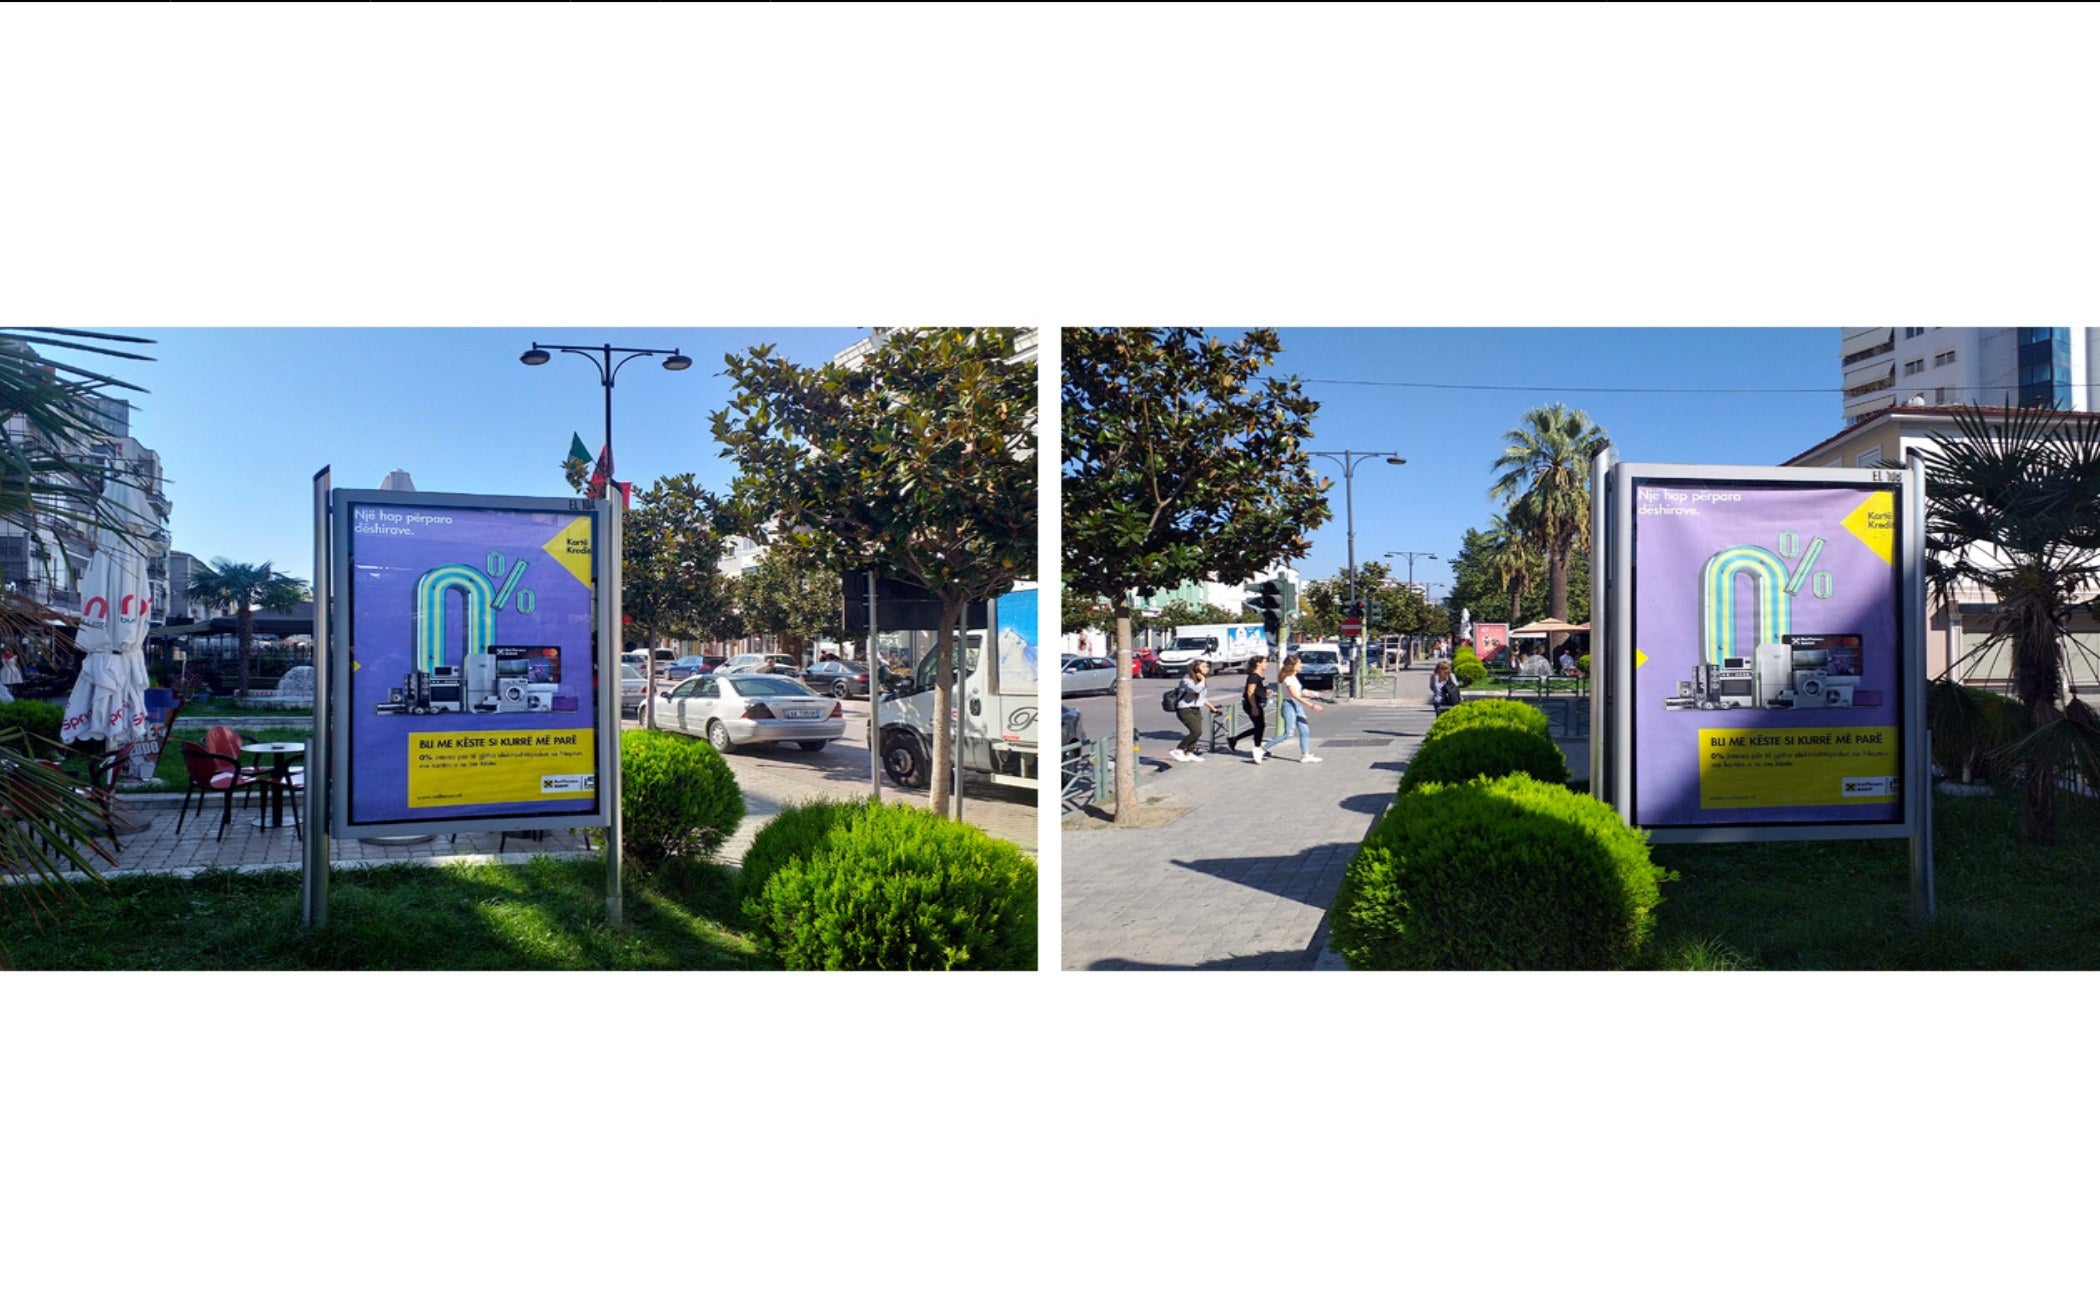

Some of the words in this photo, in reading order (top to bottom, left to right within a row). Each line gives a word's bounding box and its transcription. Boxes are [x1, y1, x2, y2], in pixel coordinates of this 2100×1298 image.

[1873, 470, 1882, 481] EL
[1639, 489, 1660, 503] Një
[1664, 488, 1688, 503] hap
[1692, 490, 1741, 504] përpara
[569, 499, 578, 510] EL
[1639, 503, 1701, 516] dëshirave.
[354, 508, 376, 522] Një
[380, 510, 403, 524] hap
[406, 511, 453, 525] përpara
[354, 522, 415, 536] dëshirave.
[1867, 520, 1893, 529] Kredi
[566, 546, 591, 554] Kredi
[419, 740, 434, 749] BLI
[437, 739, 453, 748] ME
[456, 736, 485, 748] KËSTE
[488, 738, 498, 747] SI
[501, 736, 533, 746] KURRË
[536, 735, 550, 745] MË
[554, 734, 577, 745] PARË
[1711, 737, 1726, 747] BLI
[1729, 737, 1745, 746] ME
[1750, 734, 1780, 746] KËSTE
[1784, 736, 1794, 745] SI
[1798, 733, 1832, 745] KURRË
[1836, 733, 1852, 744] MË
[1855, 732, 1883, 744] PARË
